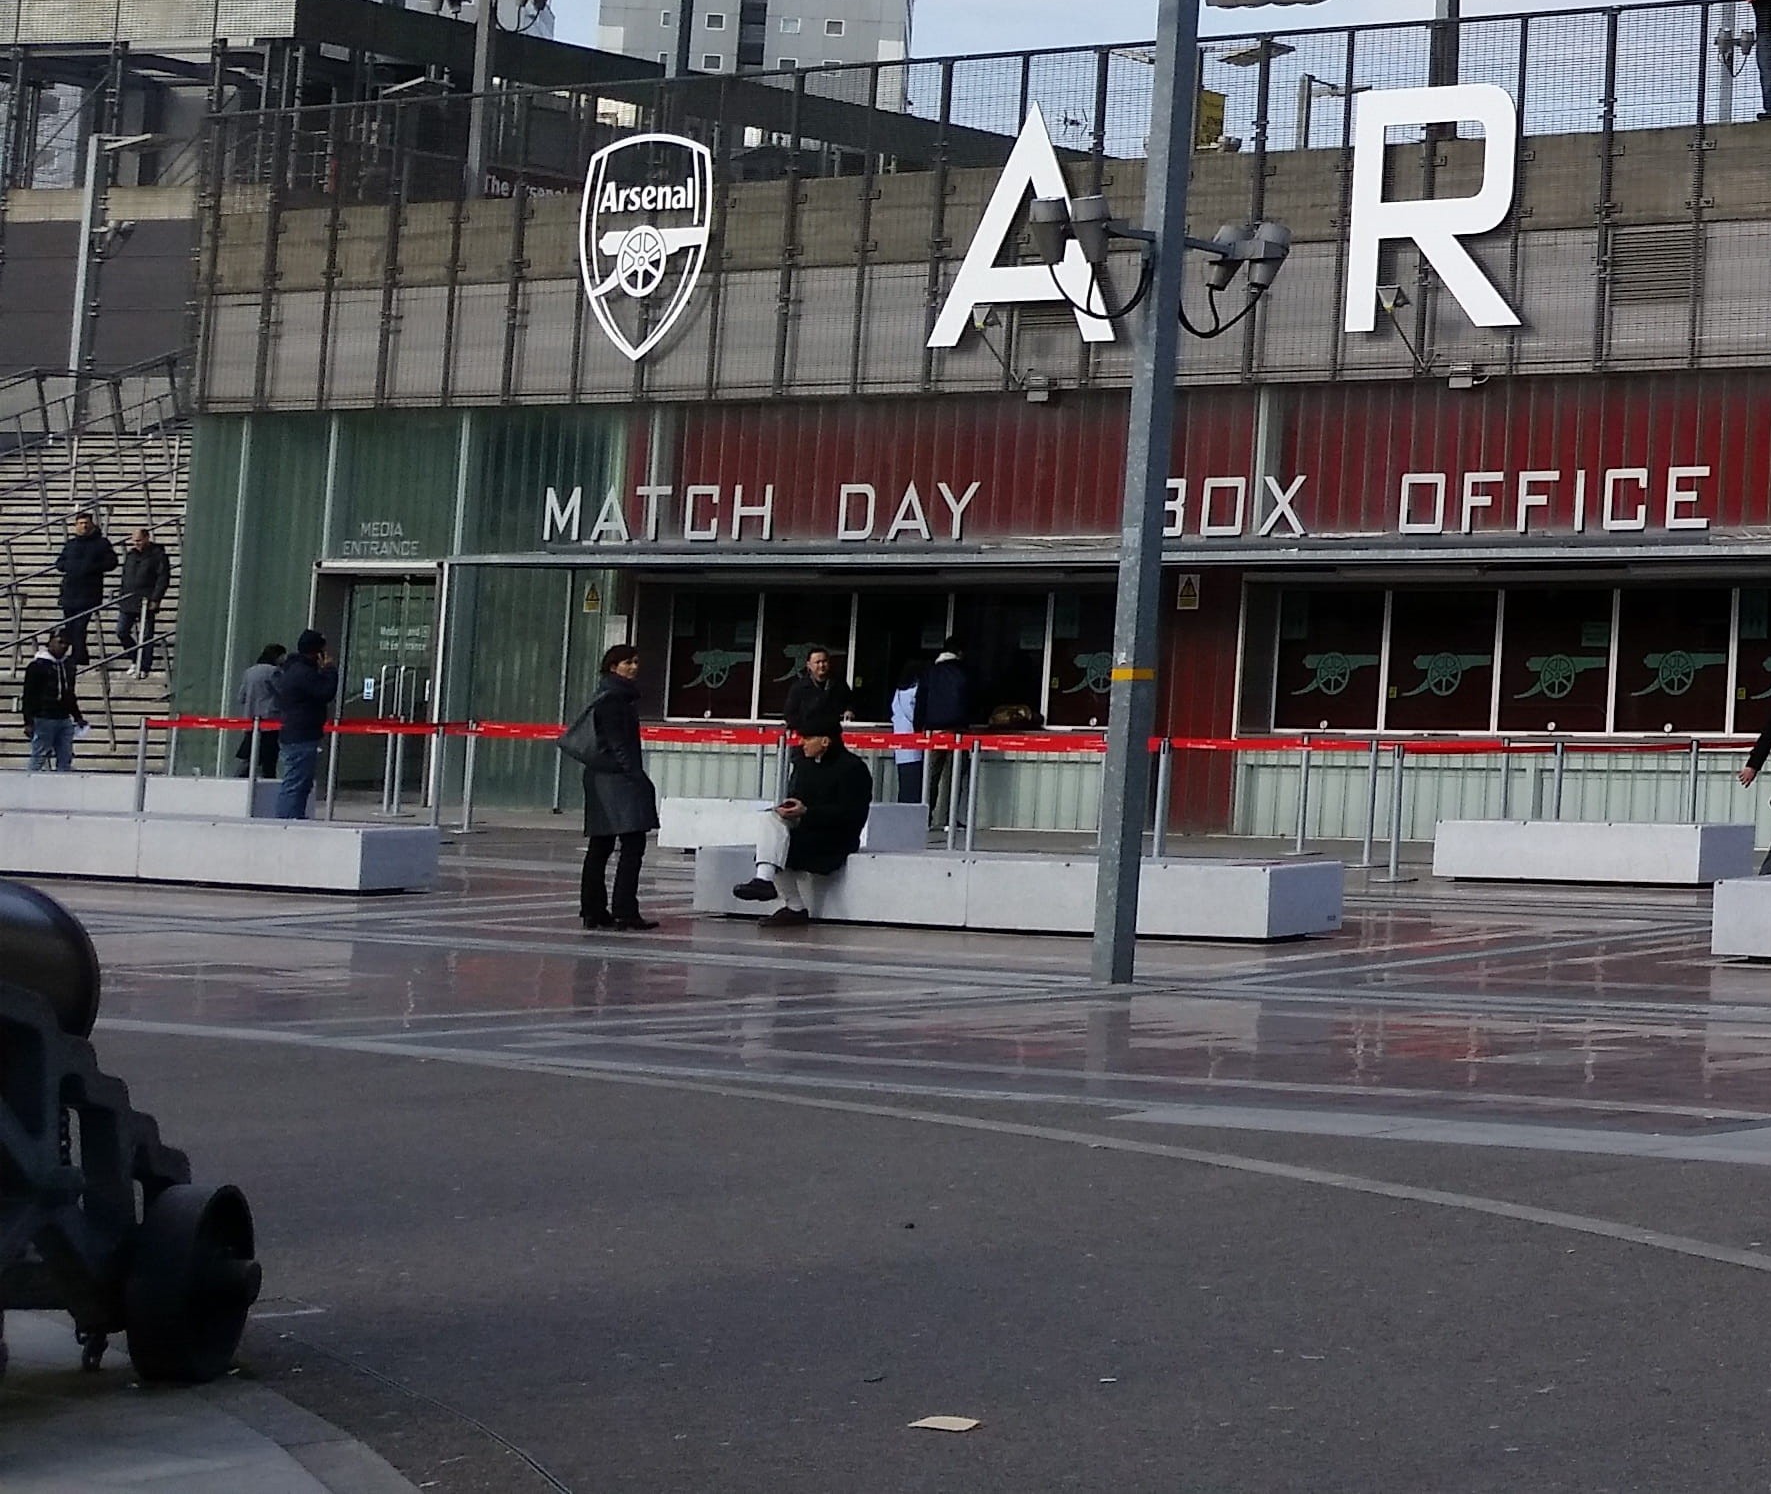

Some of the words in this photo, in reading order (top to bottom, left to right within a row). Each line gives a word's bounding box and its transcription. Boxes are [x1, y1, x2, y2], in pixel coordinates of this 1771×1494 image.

[599, 177, 694, 213] Arsenal
[543, 483, 775, 542] MATCH
[838, 479, 982, 542] DAY
[1400, 464, 1711, 534] OFFICE
[360, 521, 404, 537] MEDIA
[343, 540, 420, 556] ENTRANCE
